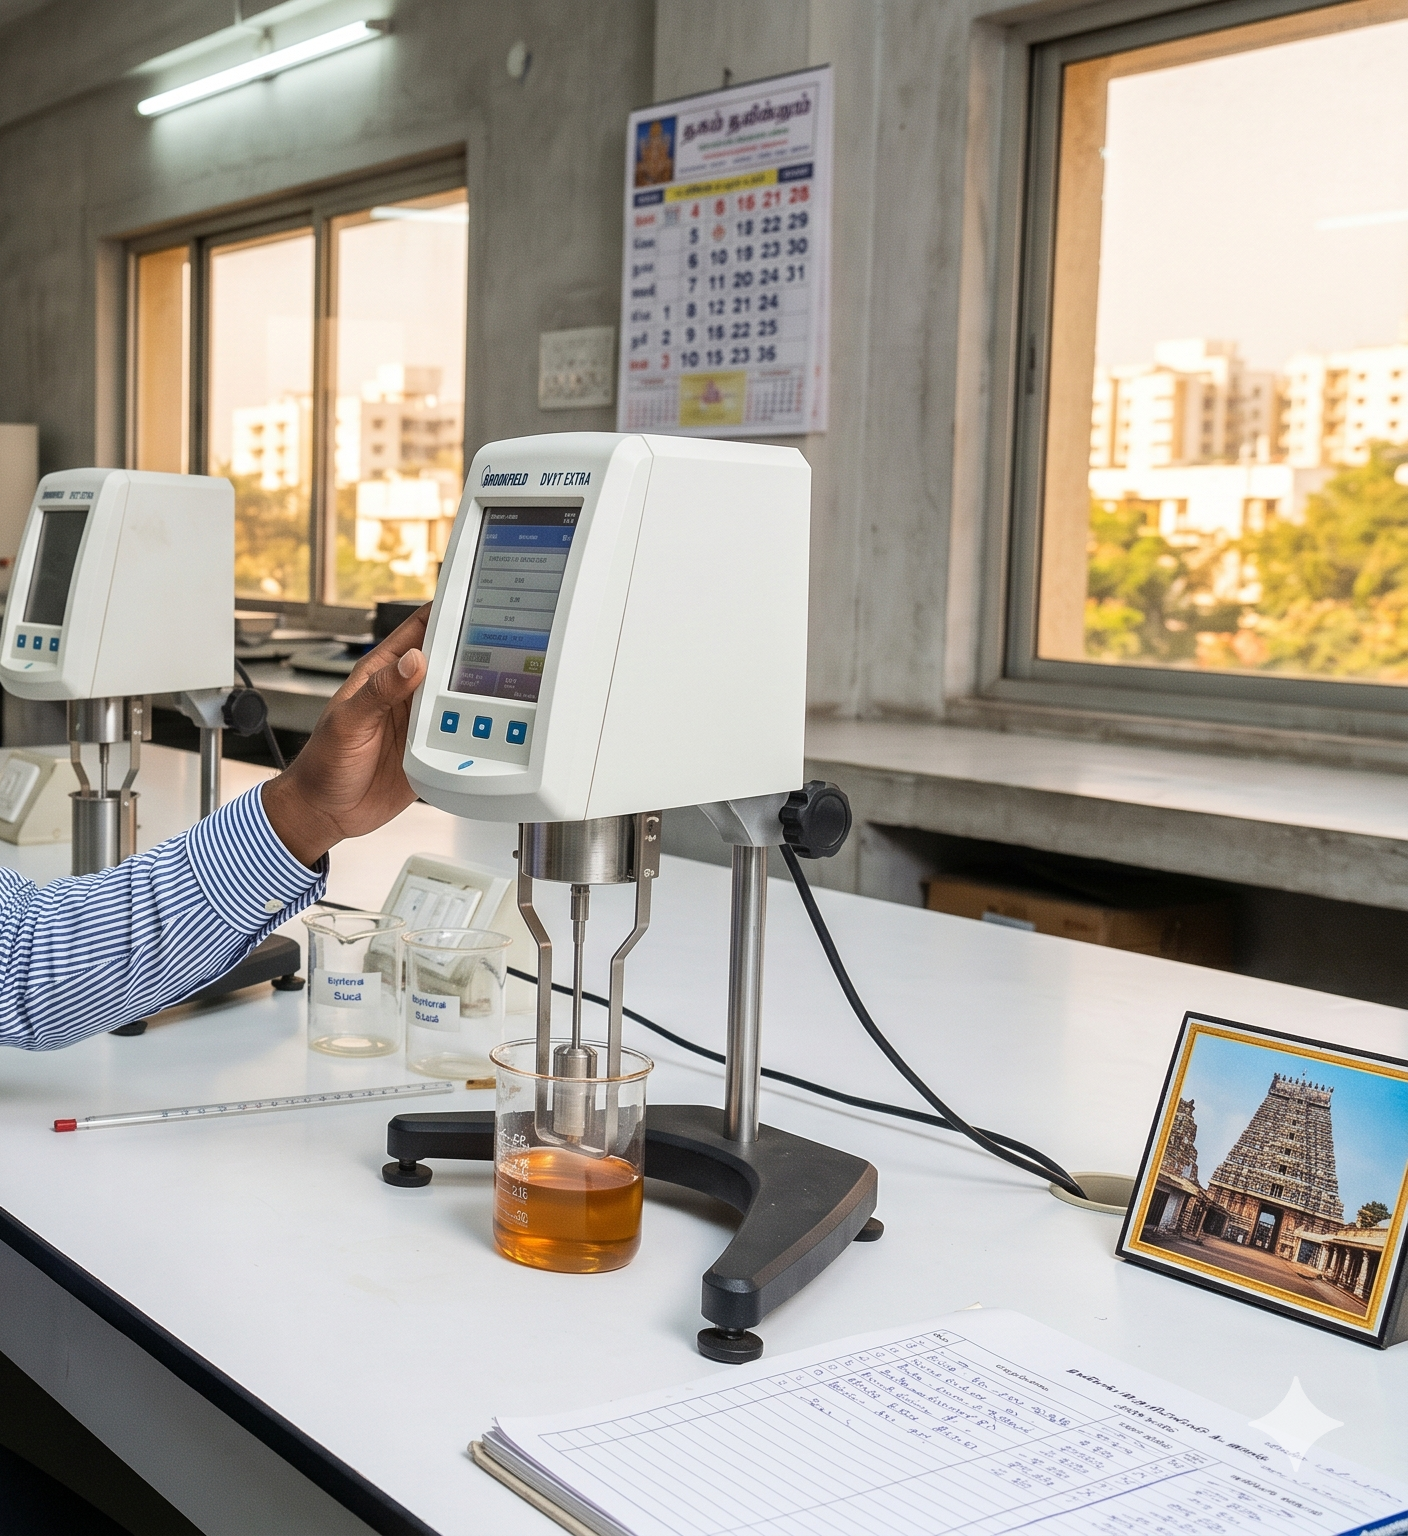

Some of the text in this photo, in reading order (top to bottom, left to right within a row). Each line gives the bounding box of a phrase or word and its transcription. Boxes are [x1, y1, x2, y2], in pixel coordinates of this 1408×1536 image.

[761, 215, 782, 235] 22
[787, 211, 809, 231] 29
[760, 240, 782, 260] 23
[787, 236, 809, 256] 30
[689, 264, 806, 293] 7 11 20 24 31
[663, 305, 671, 321] 1
[708, 299, 725, 316] 12
[732, 296, 751, 315] 21
[757, 293, 779, 312] 24
[661, 329, 671, 346] 2
[731, 321, 751, 340] 22
[757, 318, 778, 337] 25
[680, 351, 700, 368] 10
[730, 346, 751, 365] 23
[564, 471, 592, 486] EXTRA
